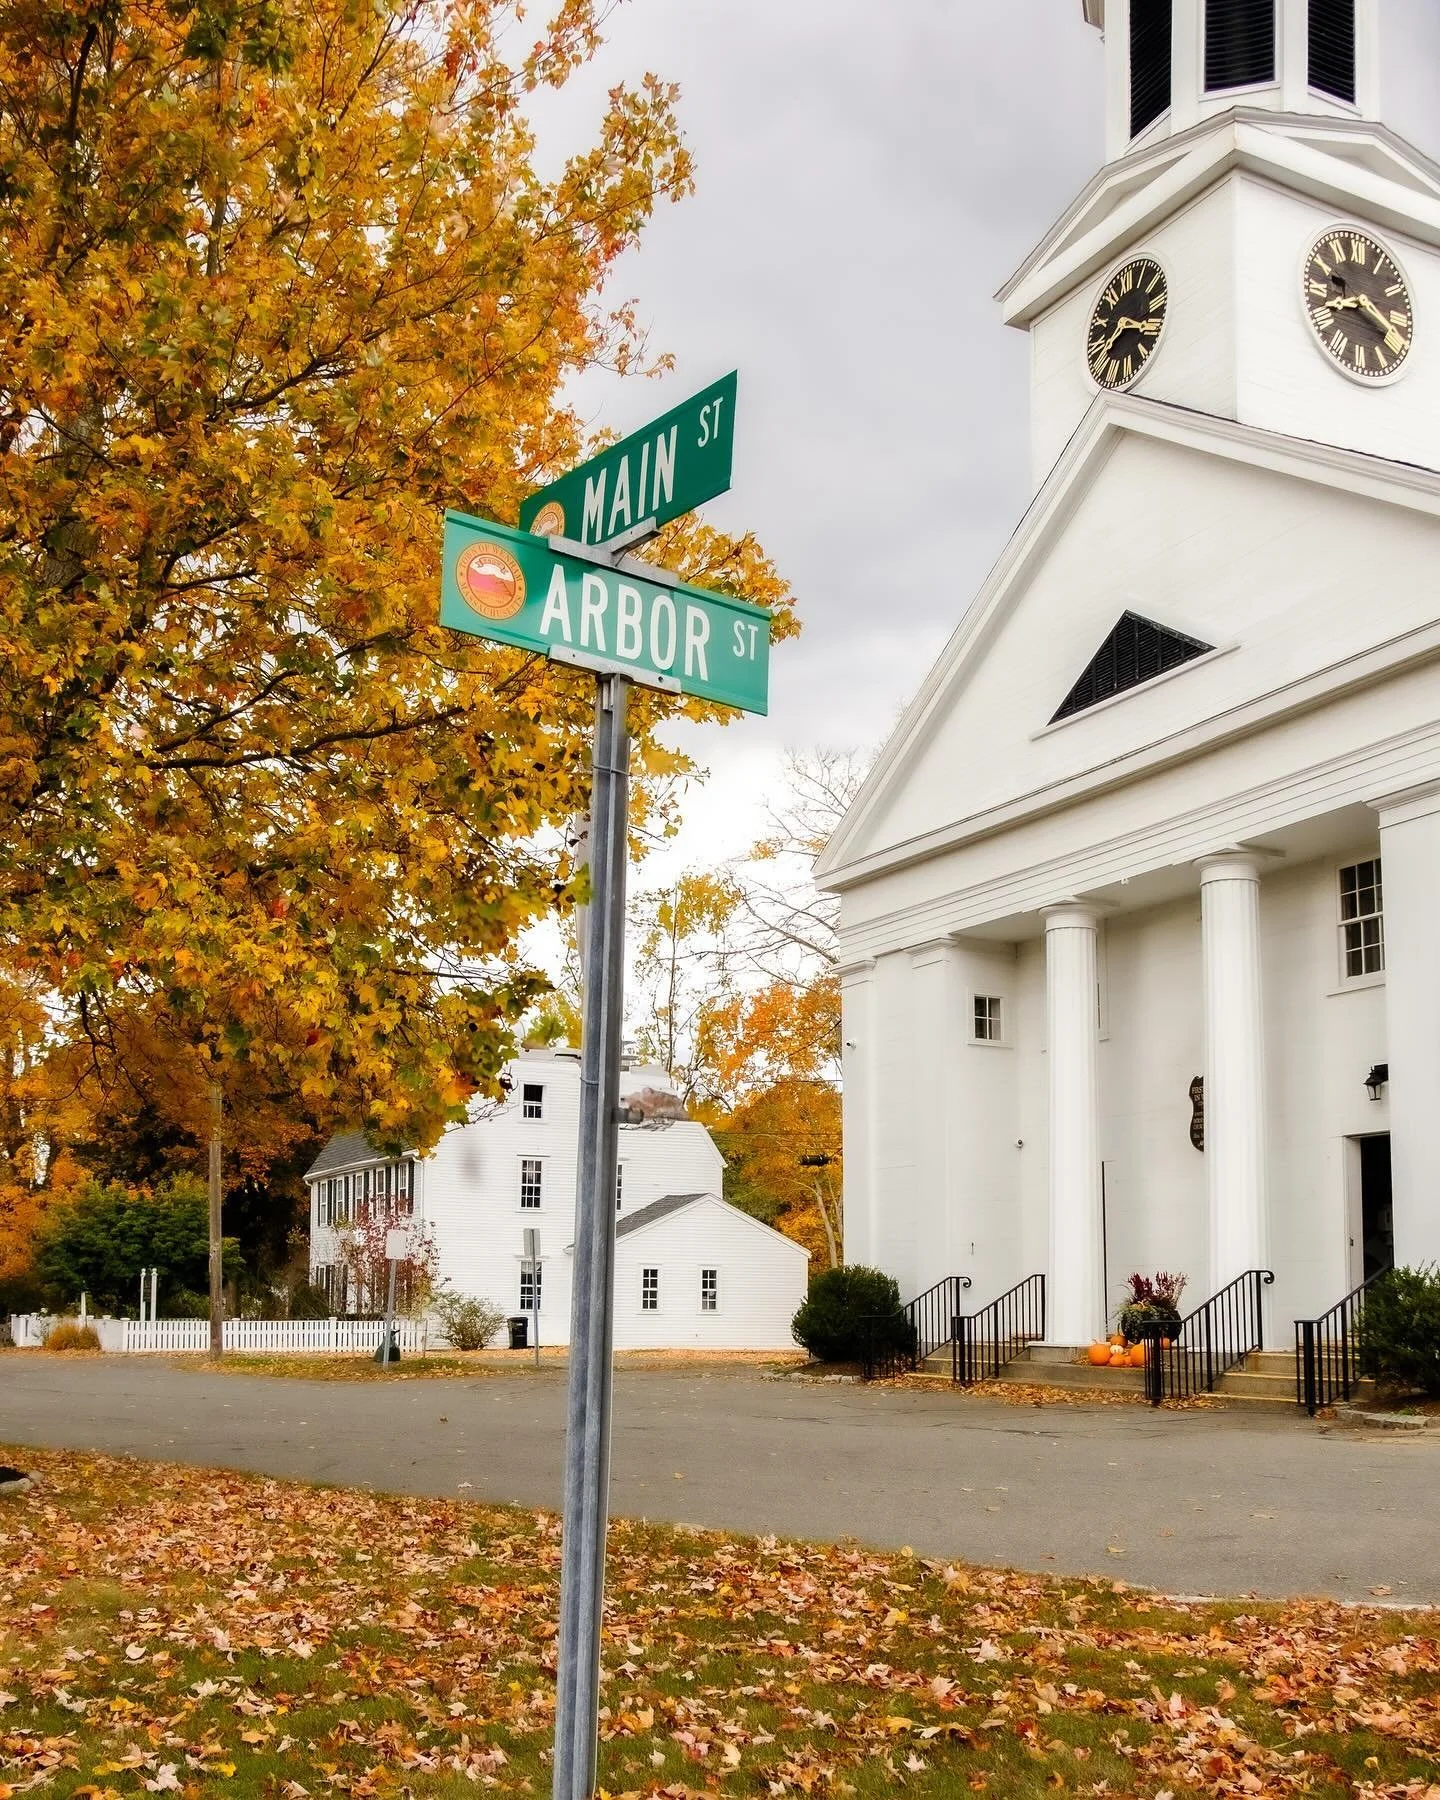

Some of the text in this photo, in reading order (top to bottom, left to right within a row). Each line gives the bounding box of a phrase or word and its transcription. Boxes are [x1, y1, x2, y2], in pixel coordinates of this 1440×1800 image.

[1350, 238, 1366, 265] XII
[580, 396, 724, 545] MAIN ST
[539, 563, 759, 682] ARBOR ST
